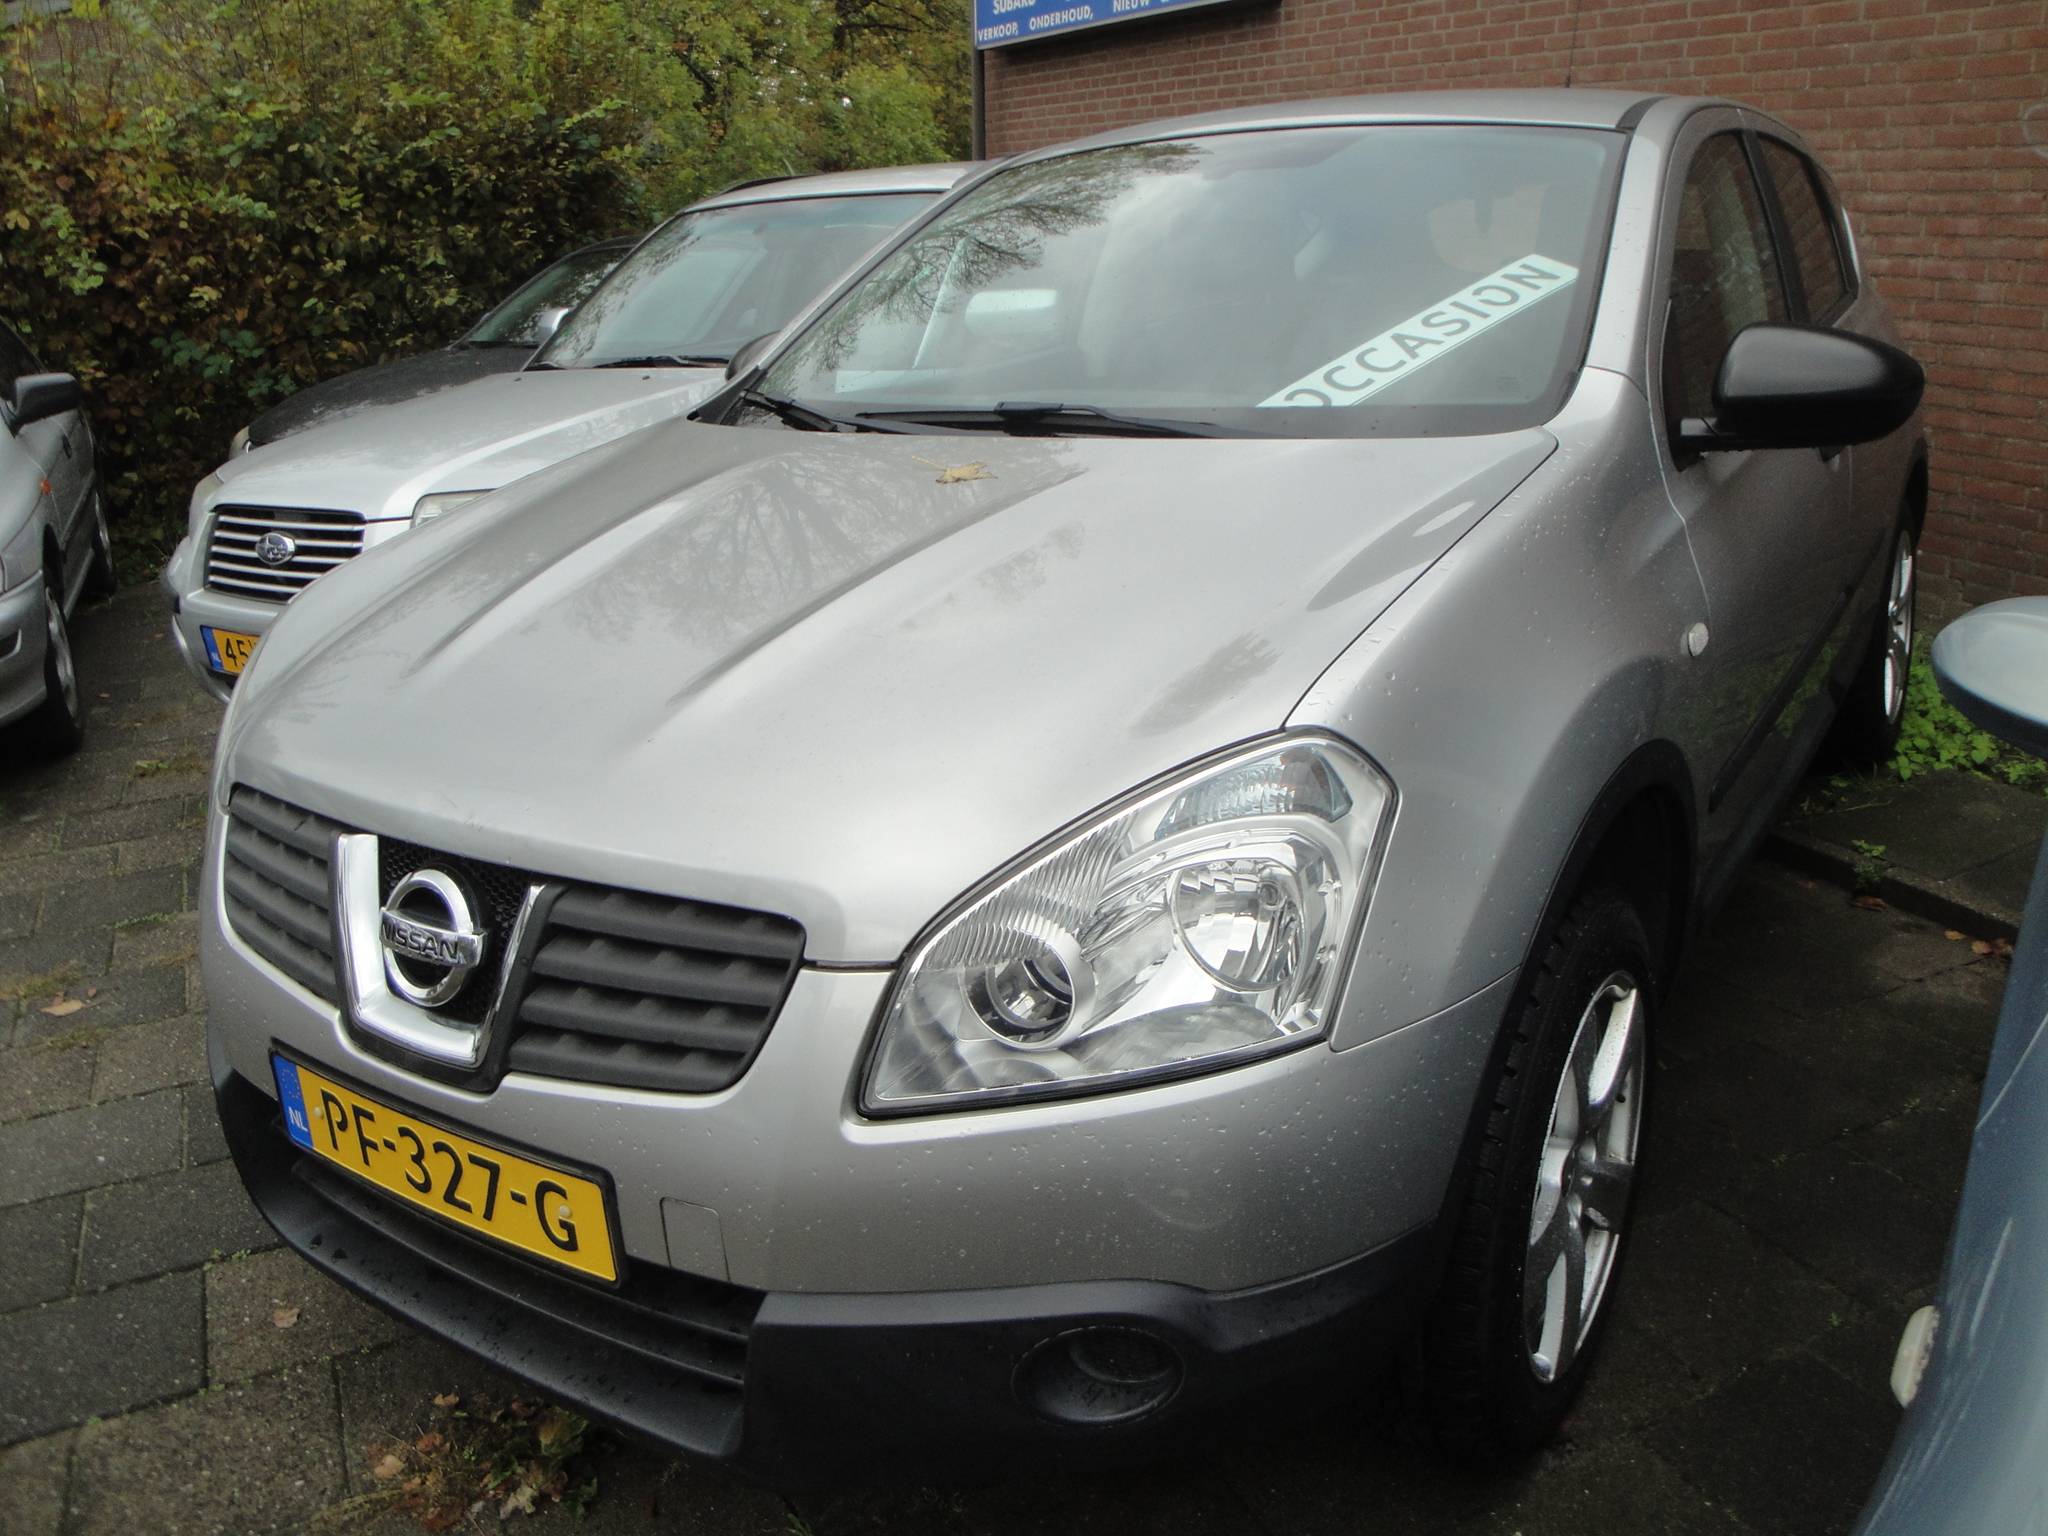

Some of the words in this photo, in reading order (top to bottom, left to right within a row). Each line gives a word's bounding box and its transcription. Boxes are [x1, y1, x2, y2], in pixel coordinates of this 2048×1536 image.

[1029, 5, 1094, 31] ONDERHOUD,
[382, 919, 462, 963] NISSAN
[288, 1105, 309, 1132] NL
[320, 1088, 579, 1252] PF-327-G
